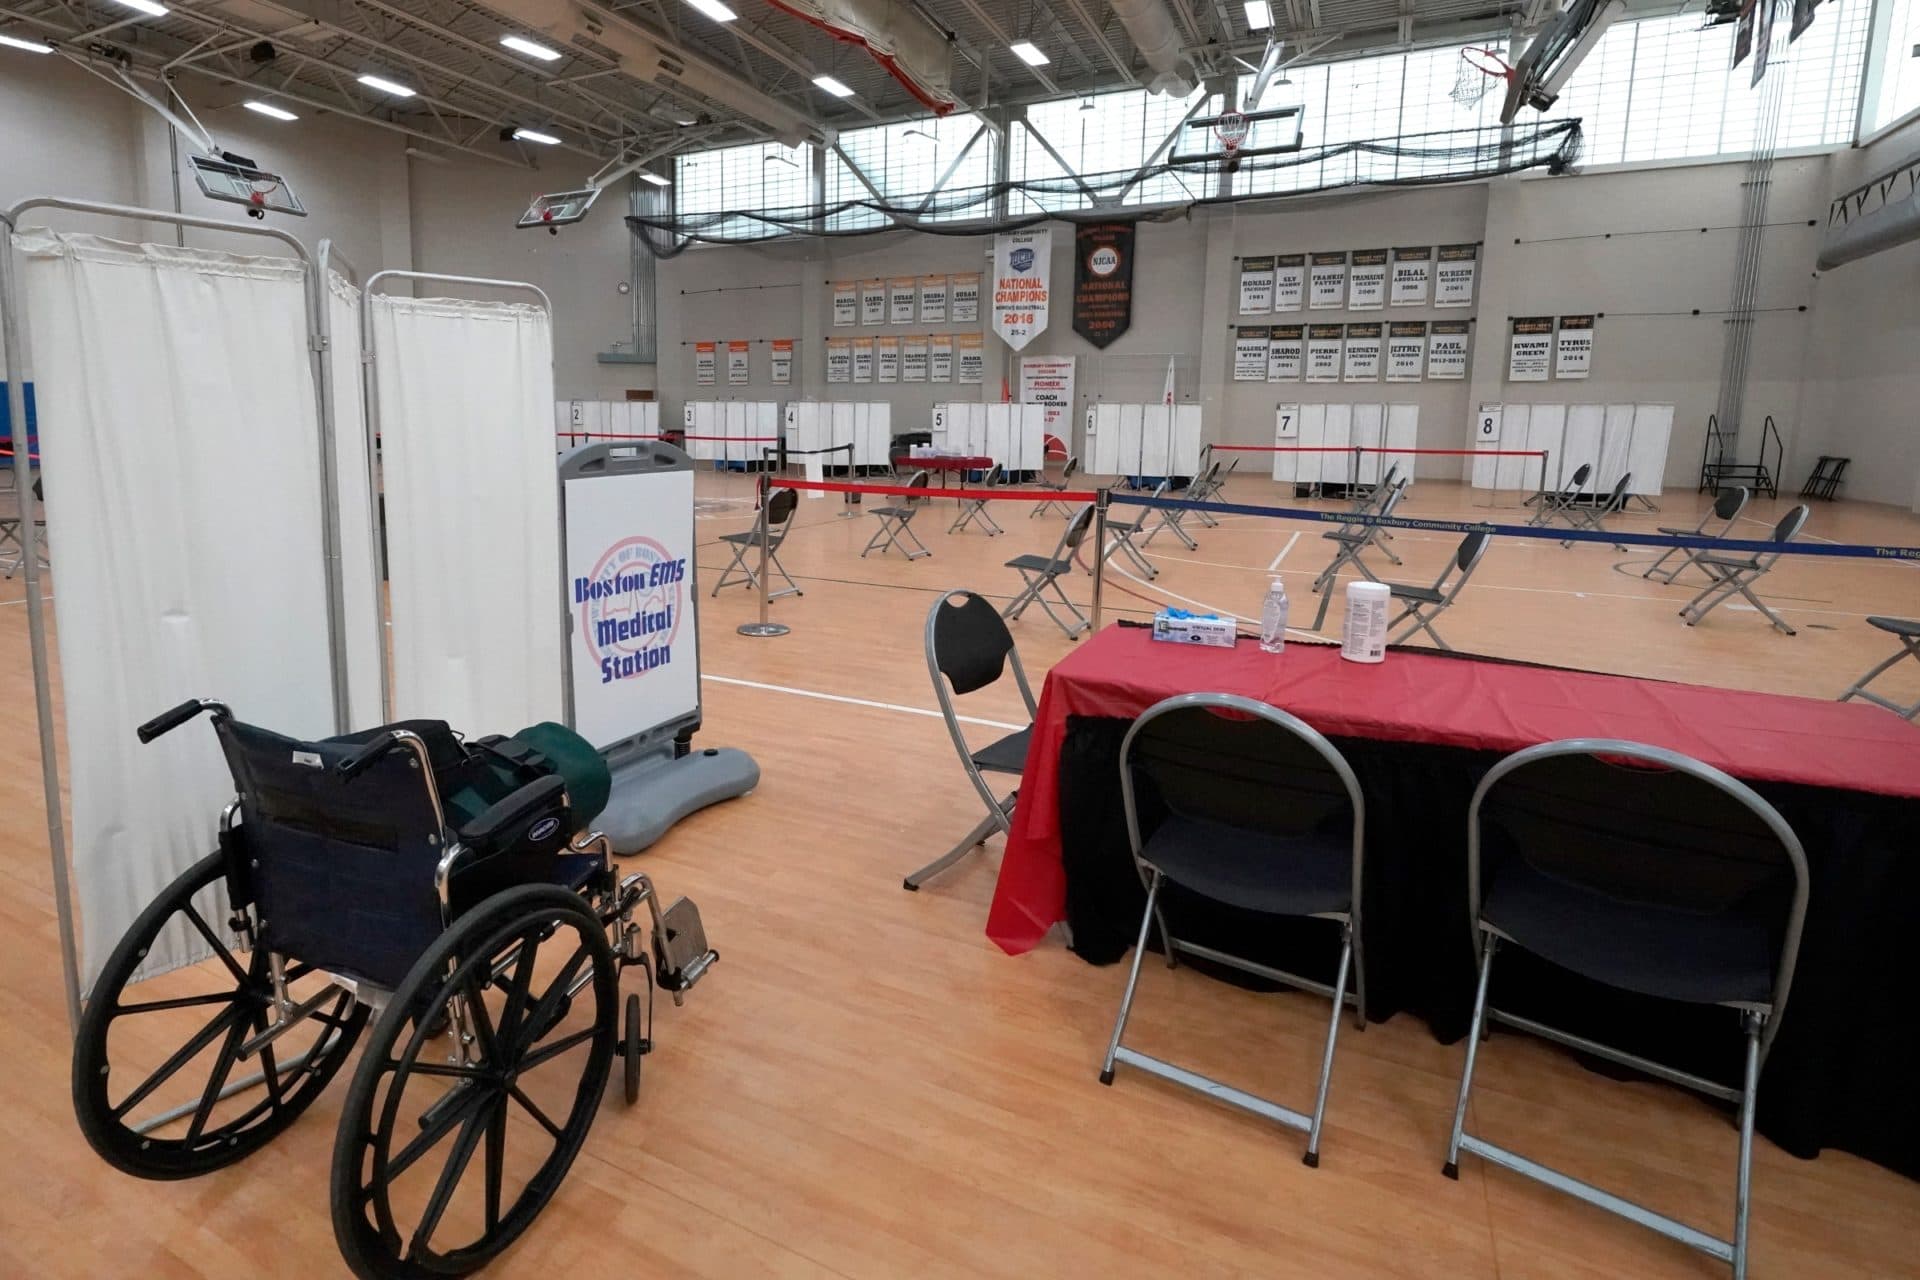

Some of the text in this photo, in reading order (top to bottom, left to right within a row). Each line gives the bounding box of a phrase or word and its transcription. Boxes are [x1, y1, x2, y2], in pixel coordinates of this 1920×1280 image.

[1092, 256, 1116, 266] NJCAA
[1397, 268, 1425, 276] BILAL
[999, 278, 1043, 290] NATIONAL
[995, 290, 1047, 303] CHAMPIONS
[1003, 313, 1034, 325] 2016
[574, 408, 580, 420] 2
[687, 410, 692, 422] 3
[788, 411, 794, 423] 4
[935, 412, 942, 426] 5
[1088, 415, 1093, 429] 6
[1282, 415, 1291, 431] 7
[1483, 417, 1493, 434] 8
[1320, 513, 1335, 521] The
[1375, 517, 1410, 528] Roxbury
[1412, 520, 1461, 531] Community
[1463, 523, 1497, 533] College
[1874, 547, 1897, 556] The
[575, 572, 645, 603] Boston
[597, 604, 671, 648] Medical
[601, 645, 670, 684] Station
